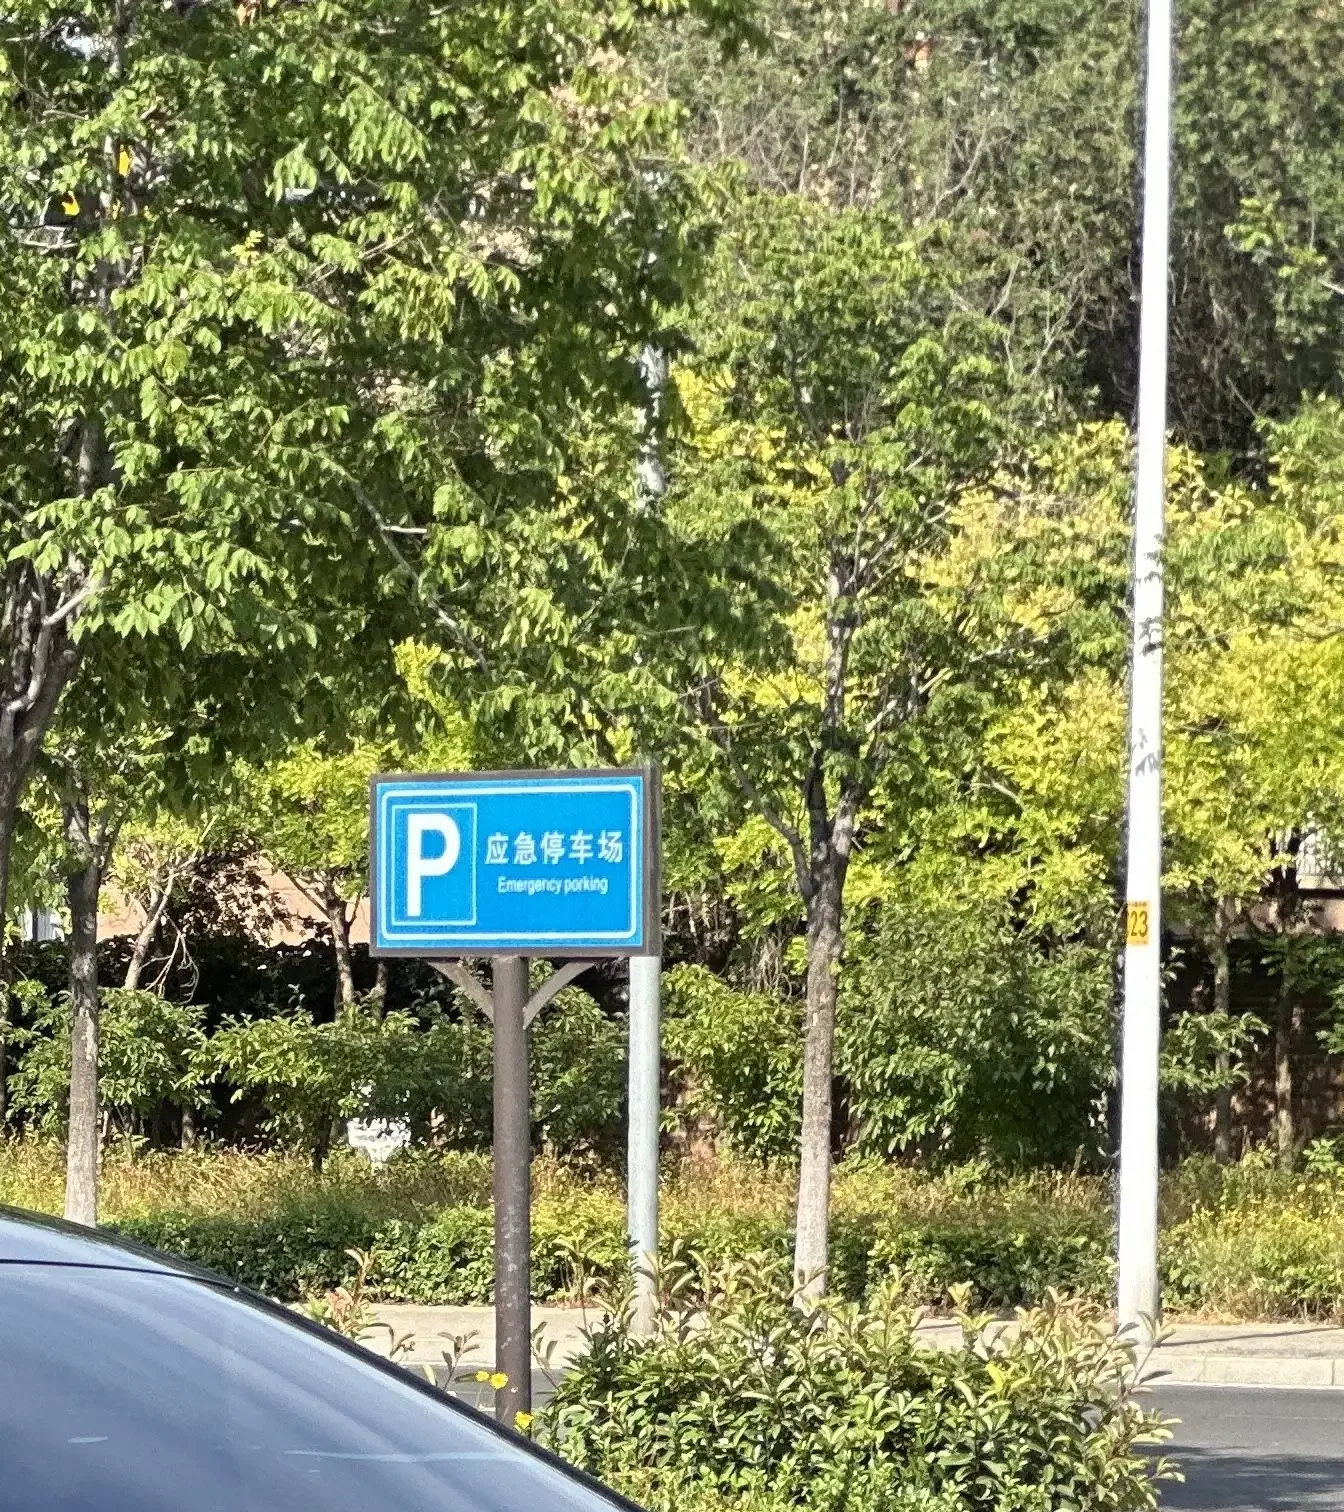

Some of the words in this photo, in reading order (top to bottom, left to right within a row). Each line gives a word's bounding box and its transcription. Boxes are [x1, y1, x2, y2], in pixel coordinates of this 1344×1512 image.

[484, 829, 624, 866] 应急停车场
[407, 813, 461, 917] P
[497, 874, 562, 896] Emergency
[563, 873, 609, 895] parking
[1126, 910, 1148, 938] 23
